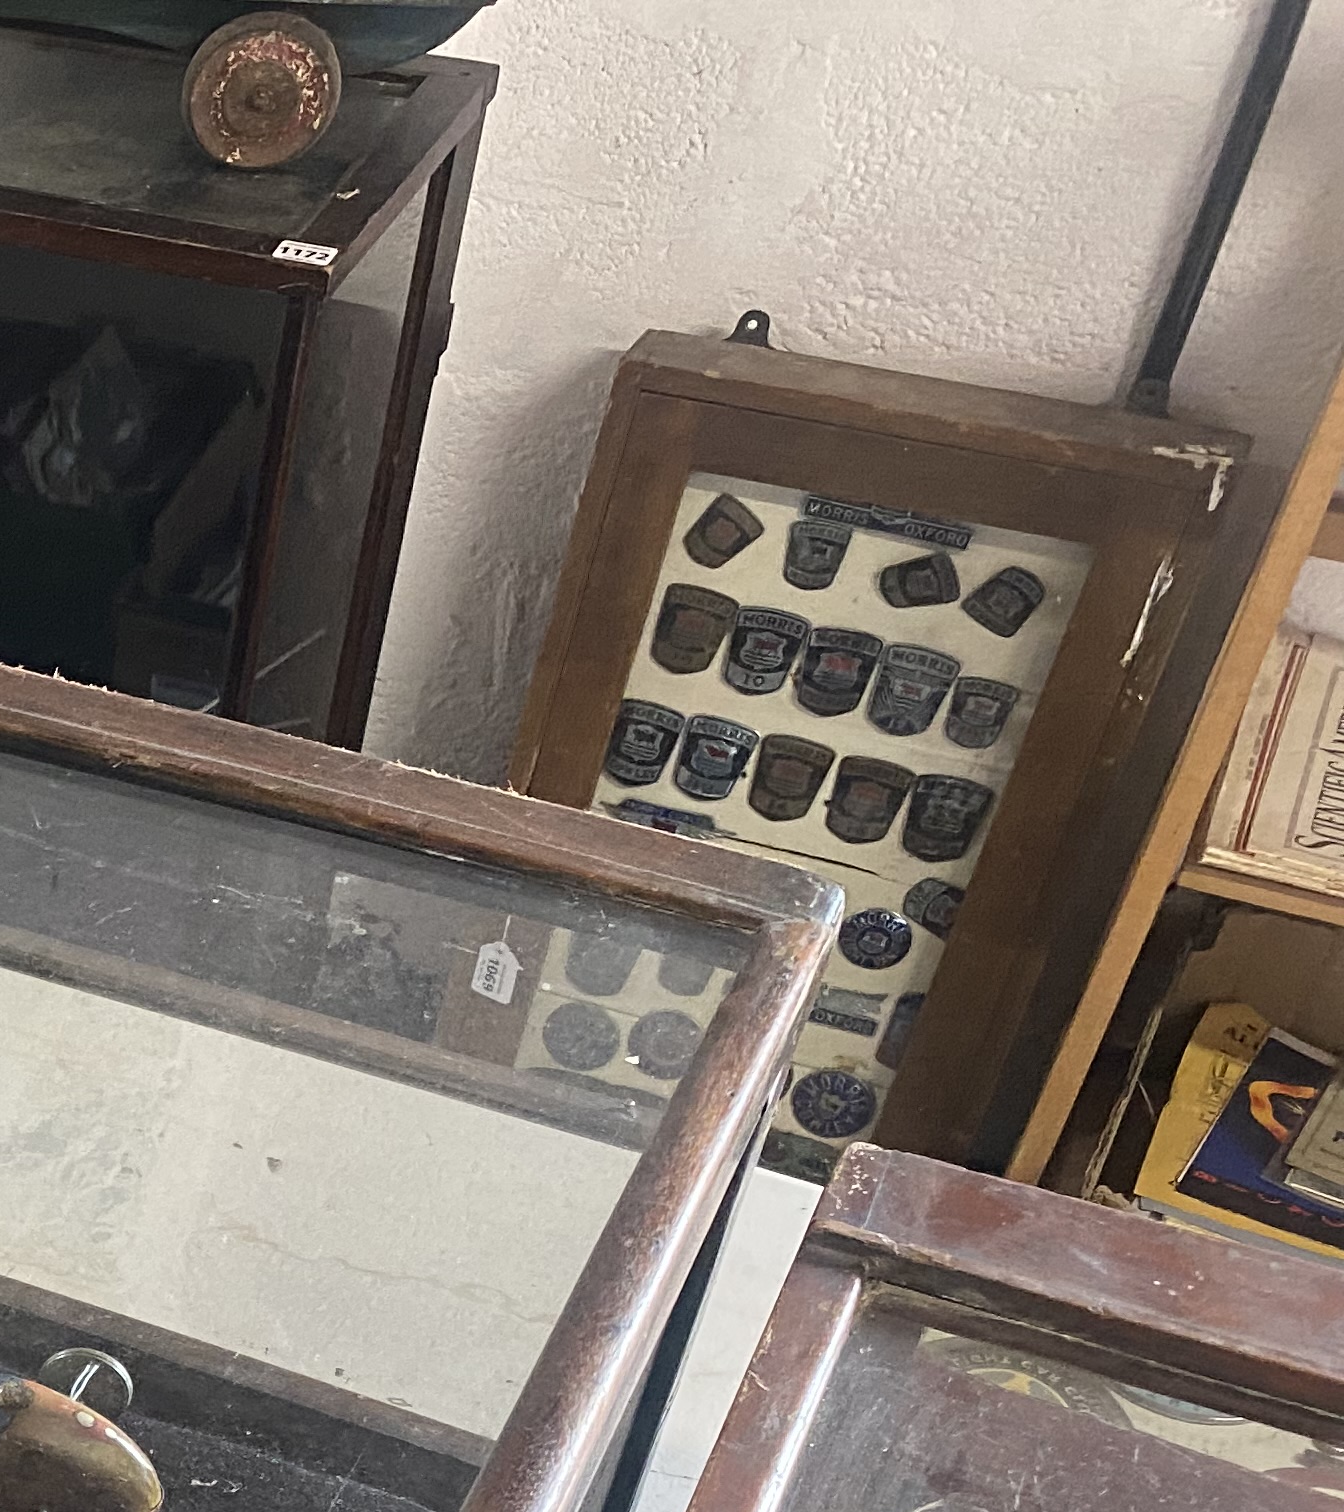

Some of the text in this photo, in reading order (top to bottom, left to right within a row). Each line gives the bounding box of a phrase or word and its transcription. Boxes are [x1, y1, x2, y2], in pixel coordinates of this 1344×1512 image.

[279, 246, 330, 261] 1172
[808, 502, 970, 548] MORRIS OXFORD
[741, 612, 803, 637] MORRIS
[889, 646, 957, 676] MORRIS
